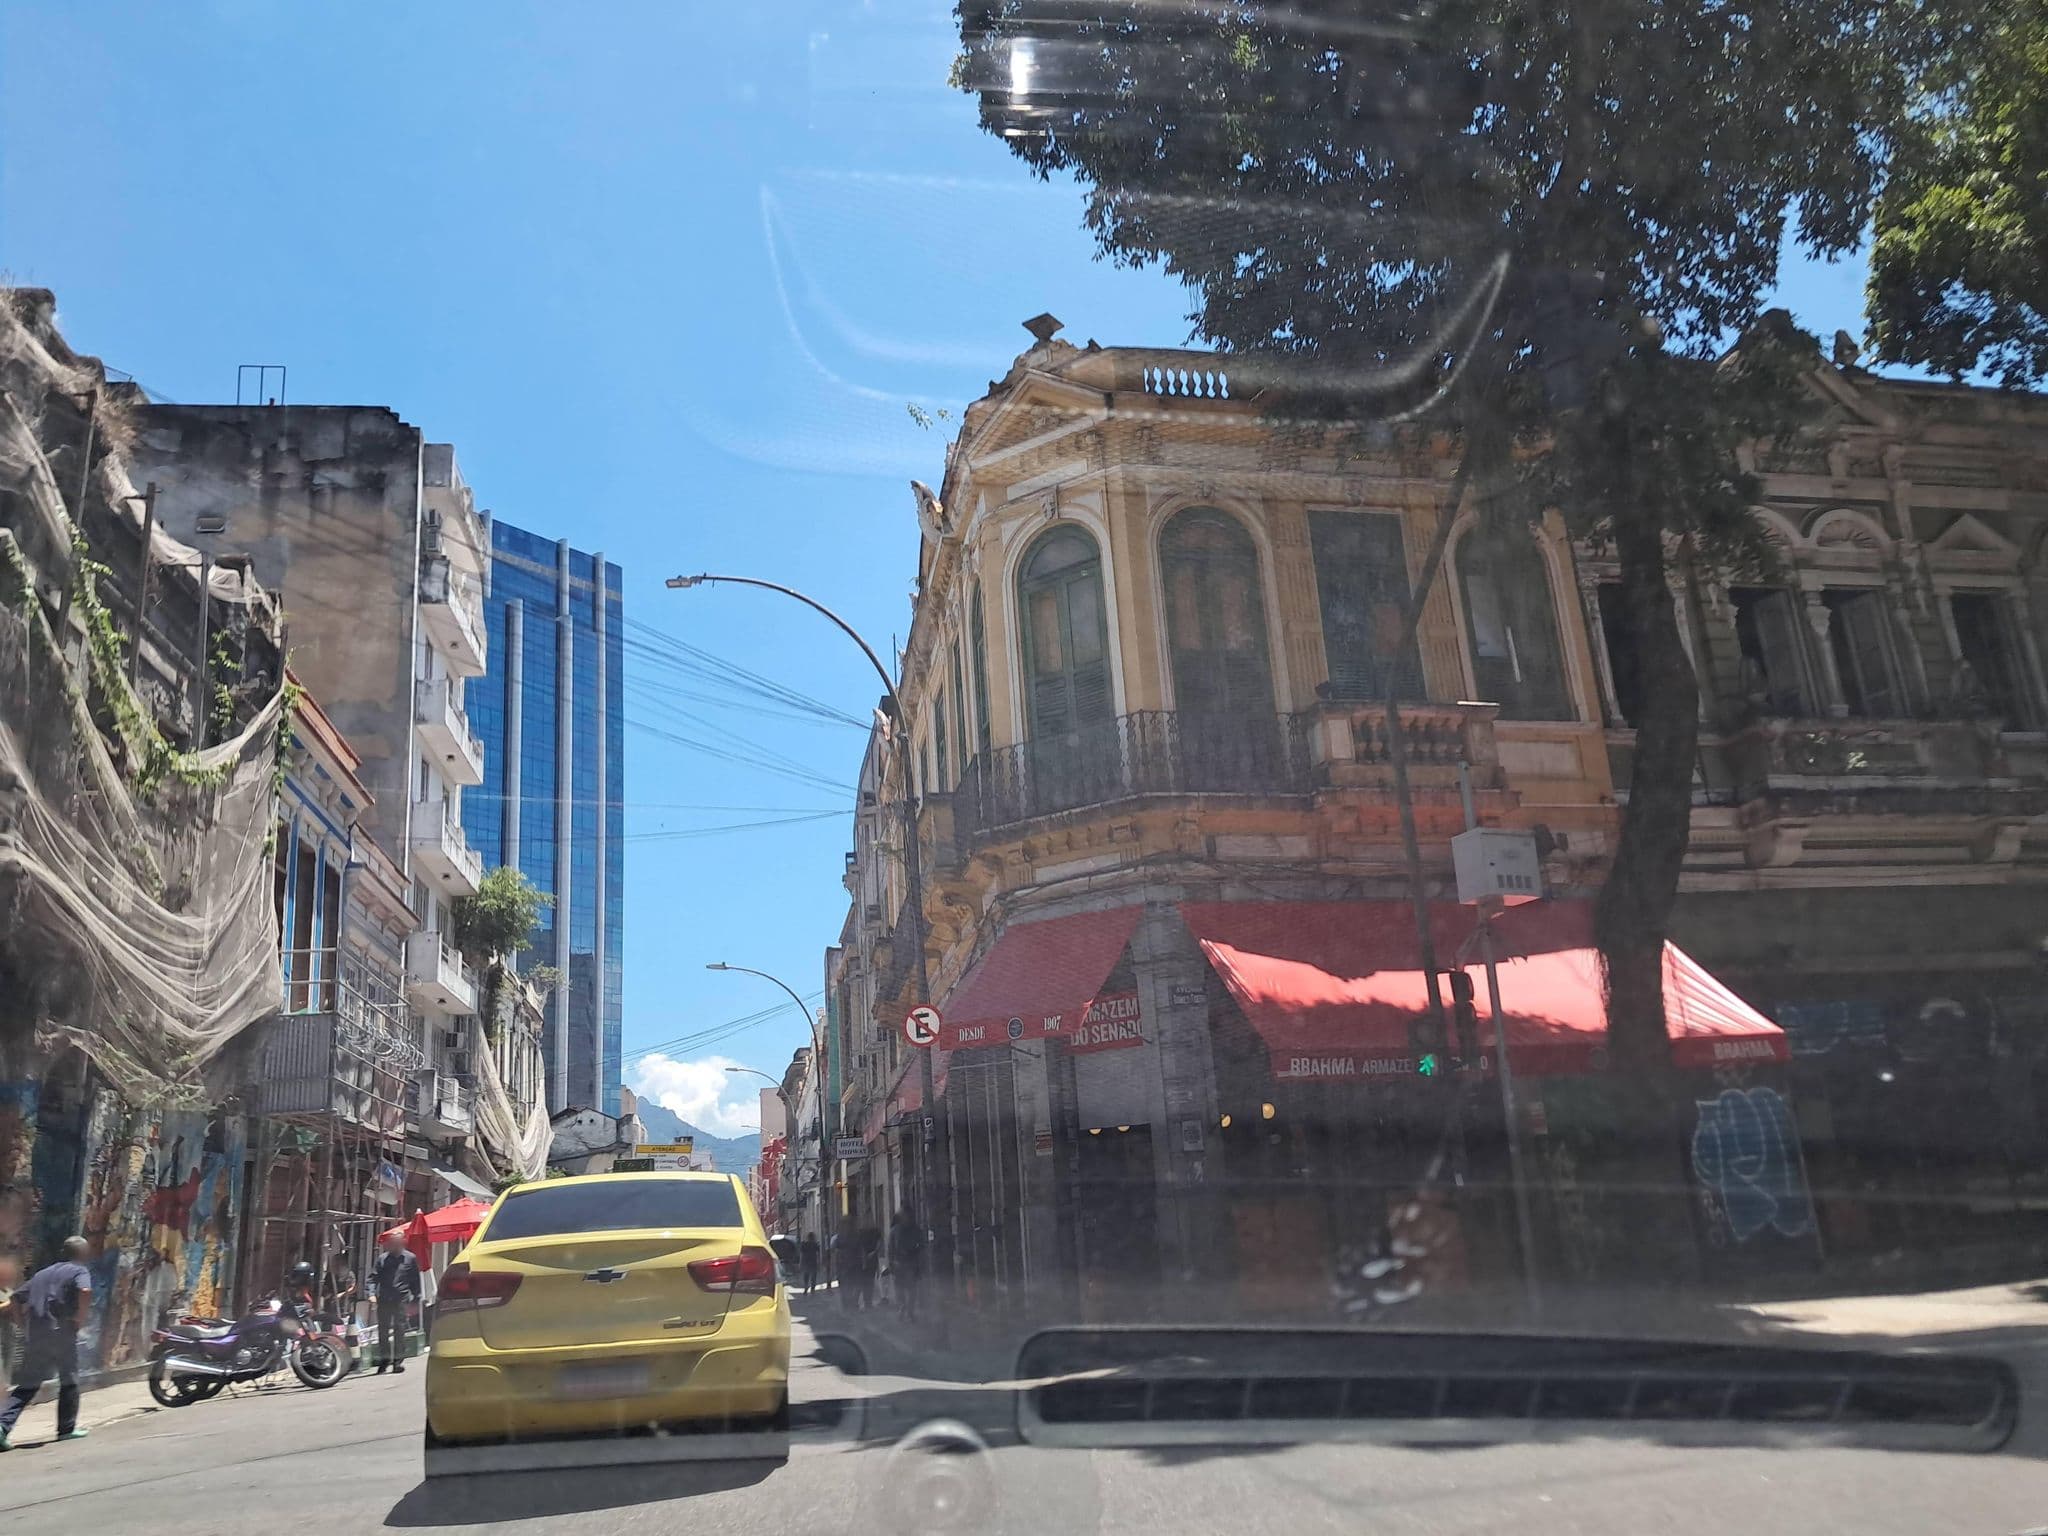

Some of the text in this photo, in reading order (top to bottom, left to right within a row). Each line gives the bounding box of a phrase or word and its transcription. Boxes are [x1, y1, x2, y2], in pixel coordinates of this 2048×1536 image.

[959, 1026, 986, 1042] DESDE
[1043, 1015, 1062, 1031] 1907
[1091, 1019, 1144, 1044] SENADO
[1713, 1040, 1776, 1059] BRAHMA
[1290, 1057, 1355, 1076] BRAHMA
[1362, 1058, 1412, 1075] ARMAZE
